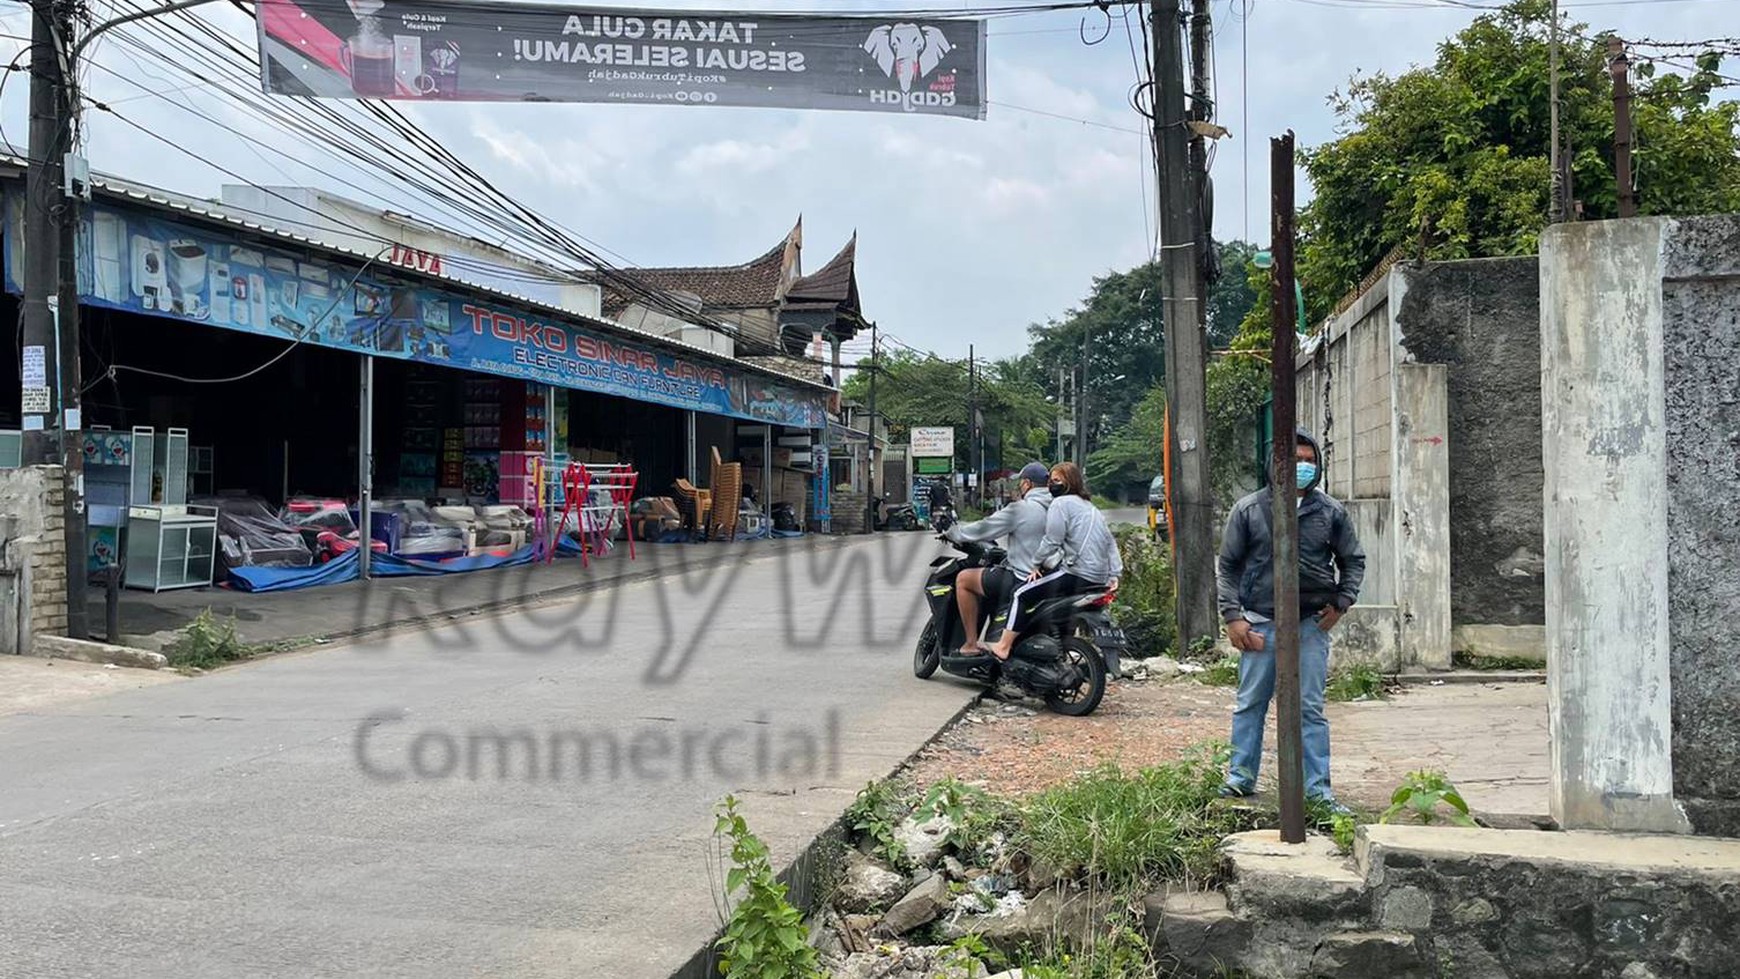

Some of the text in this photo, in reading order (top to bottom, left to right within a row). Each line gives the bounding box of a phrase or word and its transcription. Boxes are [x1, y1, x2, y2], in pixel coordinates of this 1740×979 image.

[391, 243, 442, 275] JAYA
[462, 304, 568, 353] TOKO
[575, 334, 659, 375] SINAR
[663, 359, 726, 389] JAYA
[513, 346, 611, 381] ELECTRONIC
[640, 376, 701, 400] FURNITURE
